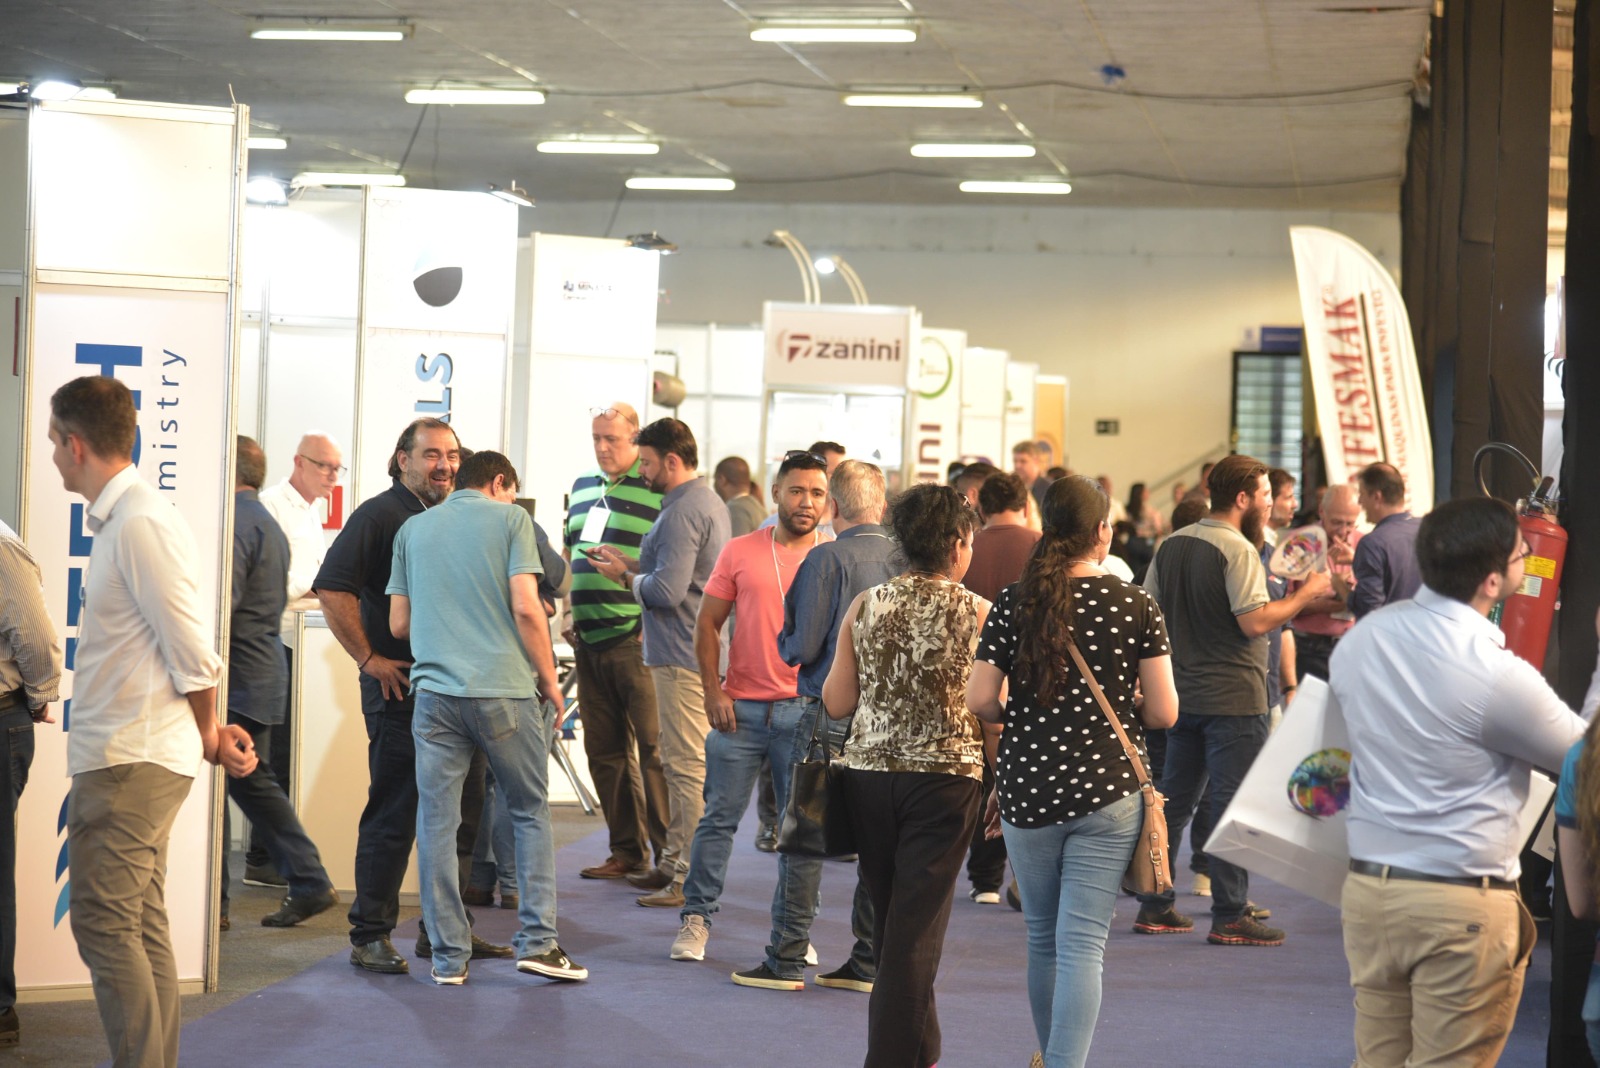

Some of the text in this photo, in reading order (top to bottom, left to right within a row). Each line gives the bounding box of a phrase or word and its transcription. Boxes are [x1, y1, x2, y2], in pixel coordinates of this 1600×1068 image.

[815, 338, 901, 361] zanini
[414, 353, 453, 423] LS
[152, 349, 187, 506] mistry
